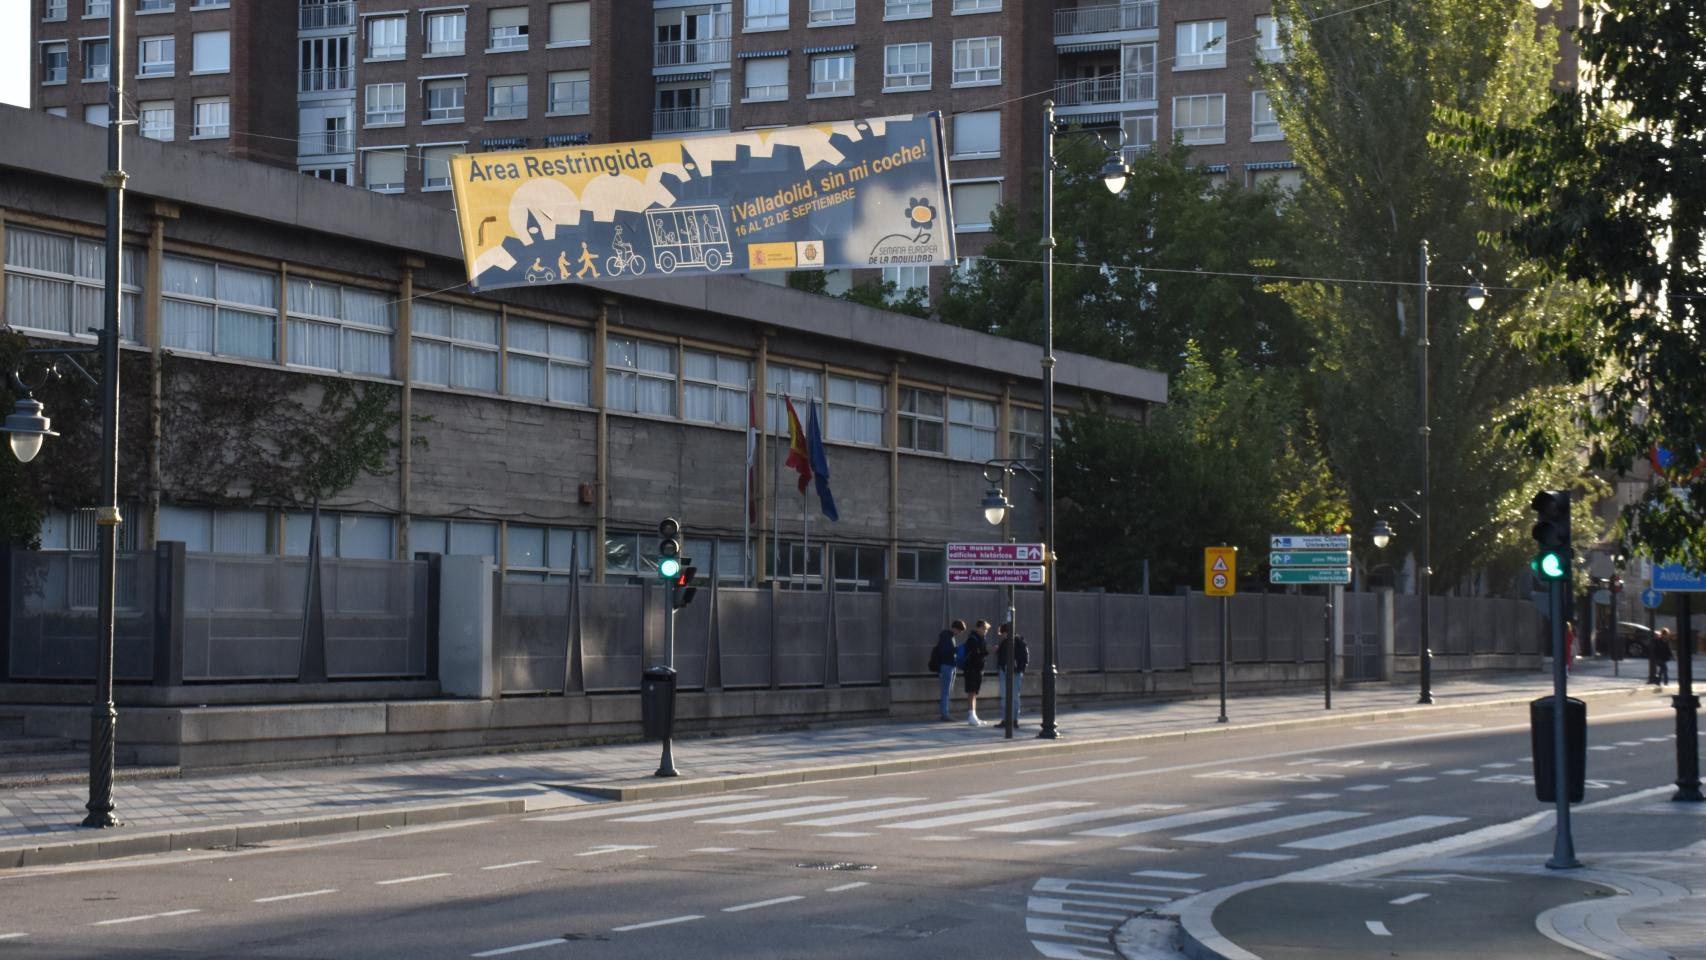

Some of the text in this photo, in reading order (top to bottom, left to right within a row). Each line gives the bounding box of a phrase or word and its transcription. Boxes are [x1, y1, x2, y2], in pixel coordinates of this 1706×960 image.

[470, 148, 653, 182] Área Restringida
[731, 138, 927, 223] ¡Valladolid, sin mi coche!
[735, 187, 857, 237] 16 AL 22 DE SEPTIEMBRE
[868, 254, 933, 265] DE LA MOVILIDAD
[879, 244, 938, 255] SEMANA EUROPEA
